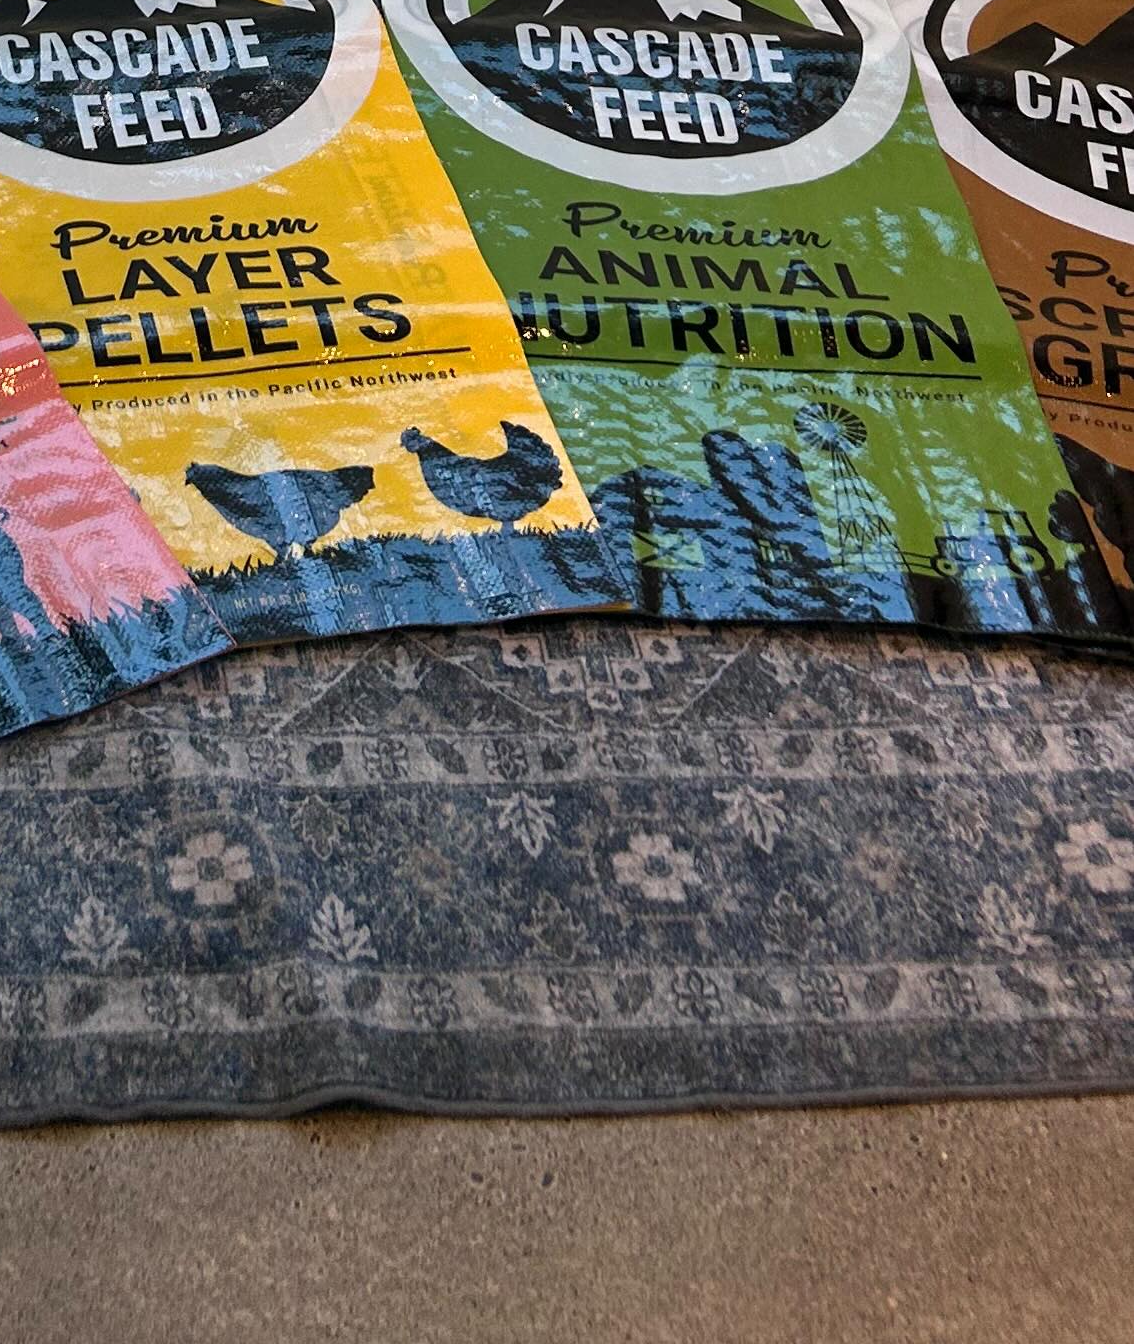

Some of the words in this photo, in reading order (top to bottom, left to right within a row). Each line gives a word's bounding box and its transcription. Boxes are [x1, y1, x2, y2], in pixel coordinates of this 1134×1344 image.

[514, 22, 792, 85] CASCADE
[71, 85, 222, 150] FEED
[589, 86, 741, 145] FEED
[50, 214, 319, 260] Premium
[562, 201, 831, 250] Premium
[61, 245, 343, 306] LAYER
[538, 245, 890, 301] ANIMAL
[28, 293, 412, 368] PELLETS
[92, 393, 190, 411] Produced
[200, 390, 218, 402] in
[228, 385, 259, 400] the
[268, 379, 342, 396] Pacific
[350, 367, 457, 388] Northwest
[855, 385, 966, 403] Northwest
